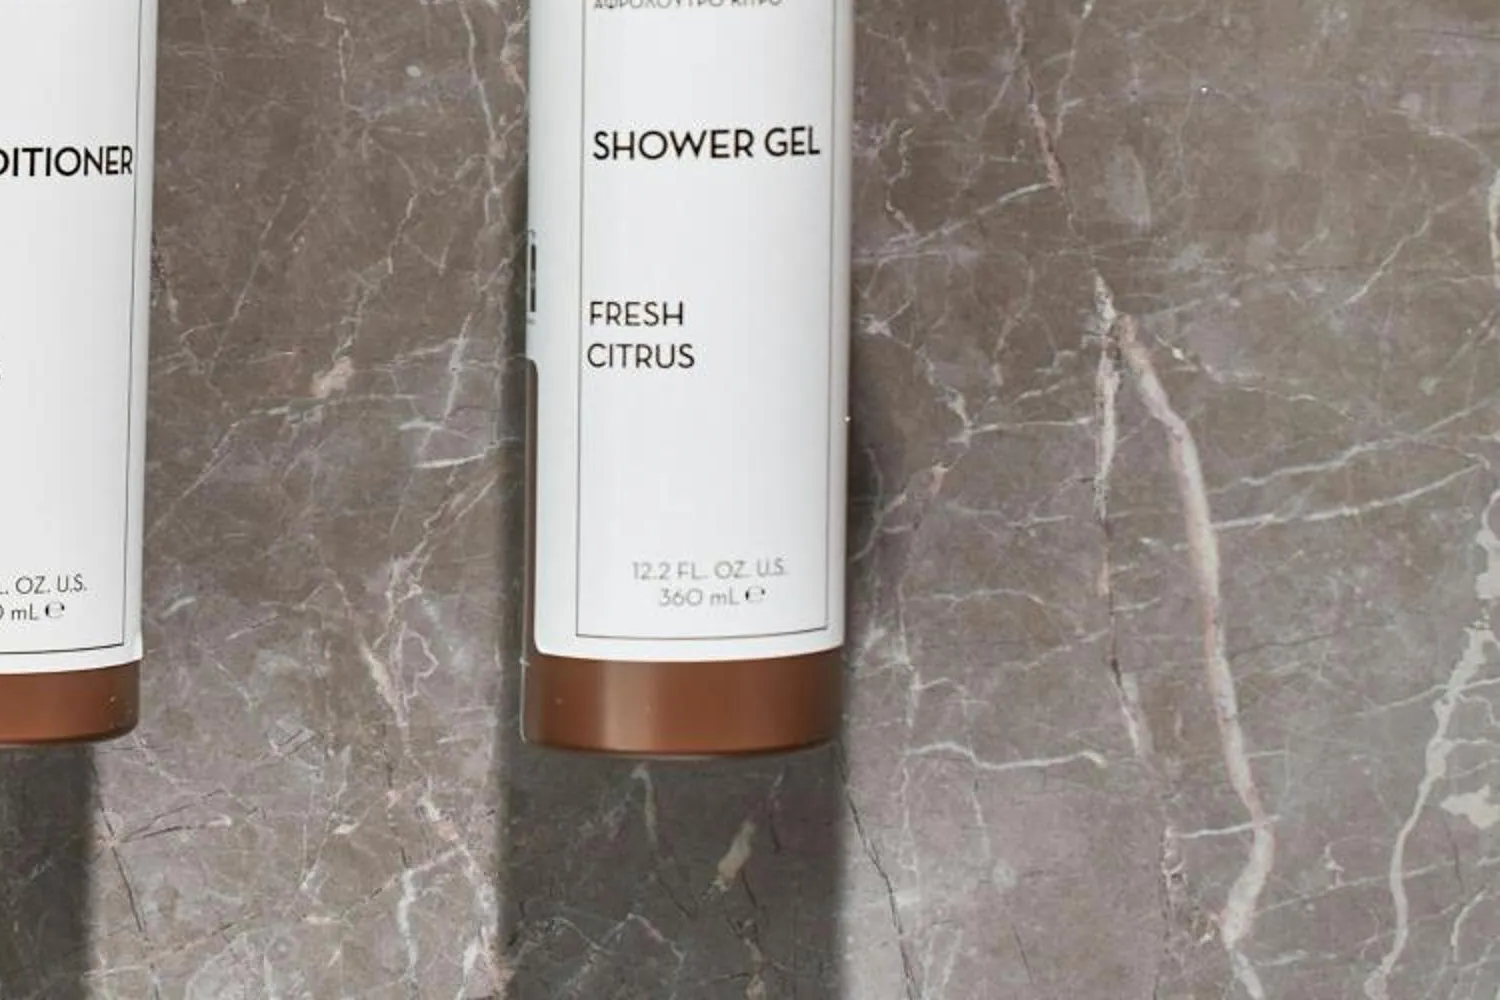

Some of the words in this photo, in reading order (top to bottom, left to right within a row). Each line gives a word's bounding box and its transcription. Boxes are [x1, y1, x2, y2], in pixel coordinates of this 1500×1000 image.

[593, 129, 755, 160] SHOWER
[764, 126, 820, 157] GEL
[590, 301, 684, 326] FRESH
[587, 343, 695, 369] CITRUS
[632, 562, 671, 580] 12.2
[15, 575, 50, 595] OZ.
[57, 573, 88, 593] U.S.
[660, 588, 703, 607] 360
[710, 587, 740, 606] mL
[11, 603, 39, 621] mL
